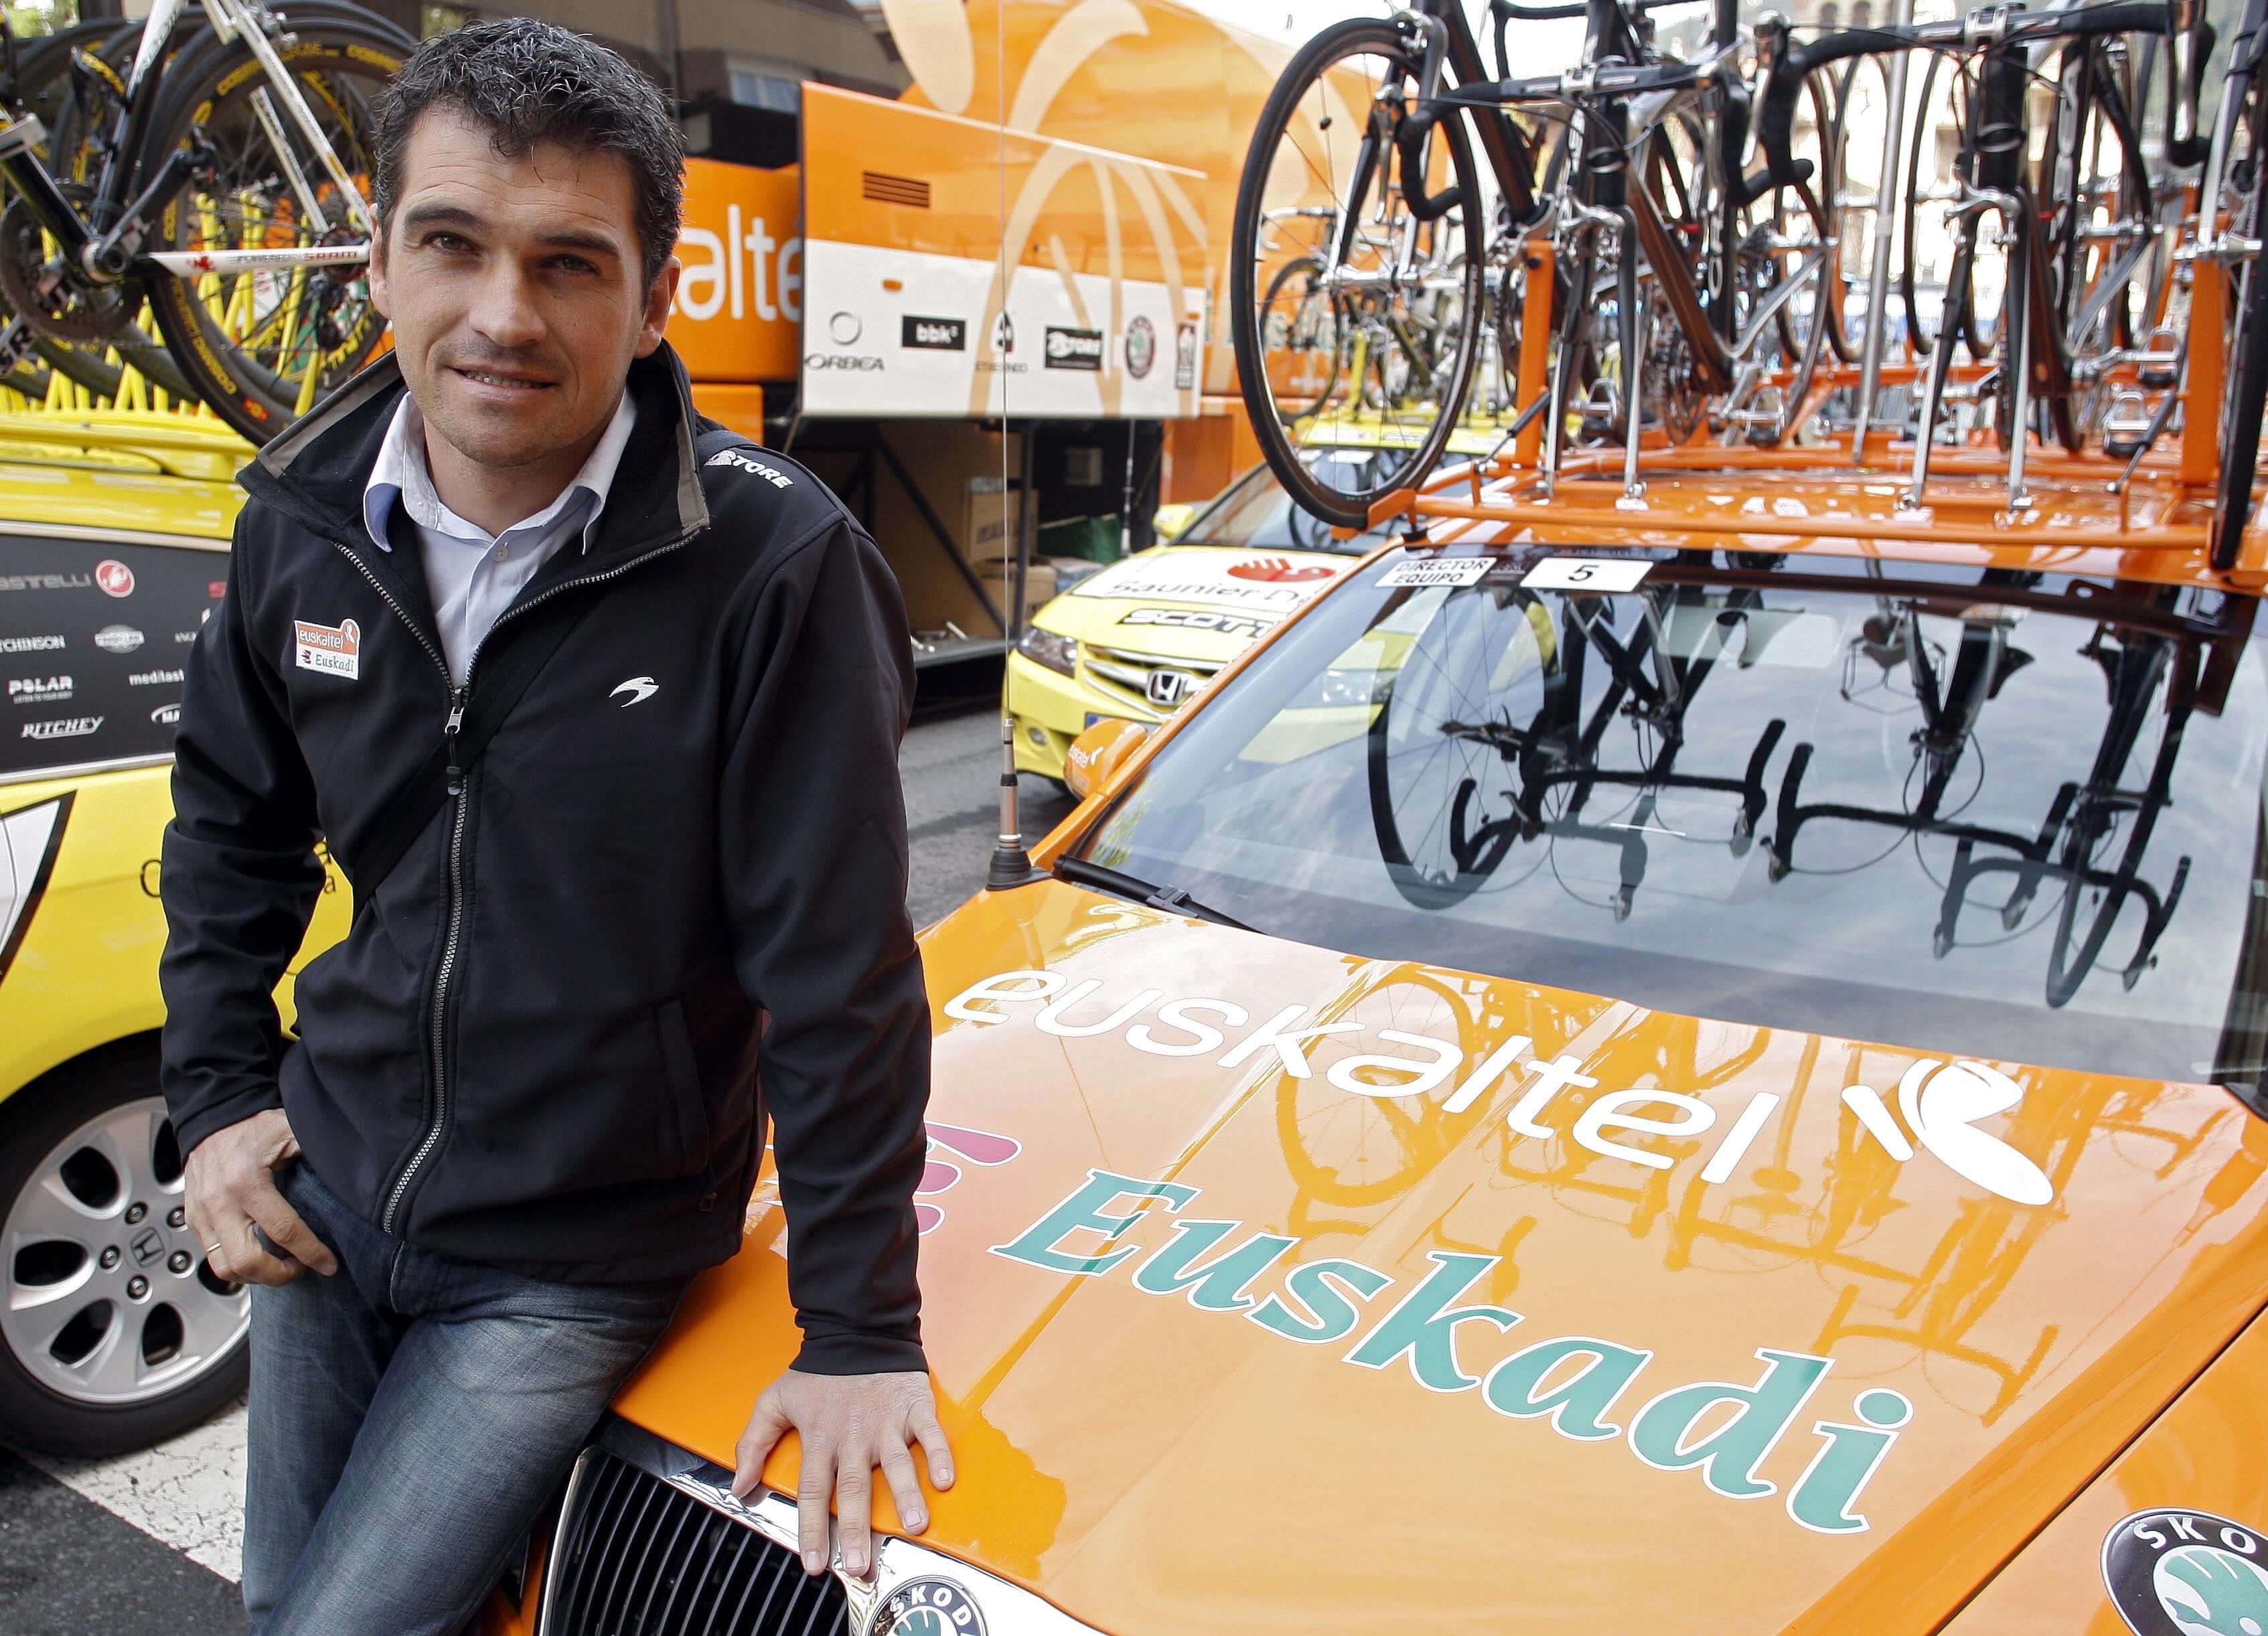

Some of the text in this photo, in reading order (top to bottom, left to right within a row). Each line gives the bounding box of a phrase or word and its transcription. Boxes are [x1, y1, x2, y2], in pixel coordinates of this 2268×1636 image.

[668, 204, 803, 323] alte
[1396, 559, 1489, 572] DIRECTOR
[1568, 565, 1600, 582] 5
[1392, 572, 1464, 583] EQUIPO
[299, 629, 344, 650] euskaltel
[315, 654, 354, 672] Euskadi
[8, 676, 73, 695] POLAR
[21, 716, 104, 739] RITCHEY
[943, 970, 1781, 1185] euskaltel
[986, 1168, 1914, 1535] Euskadi
